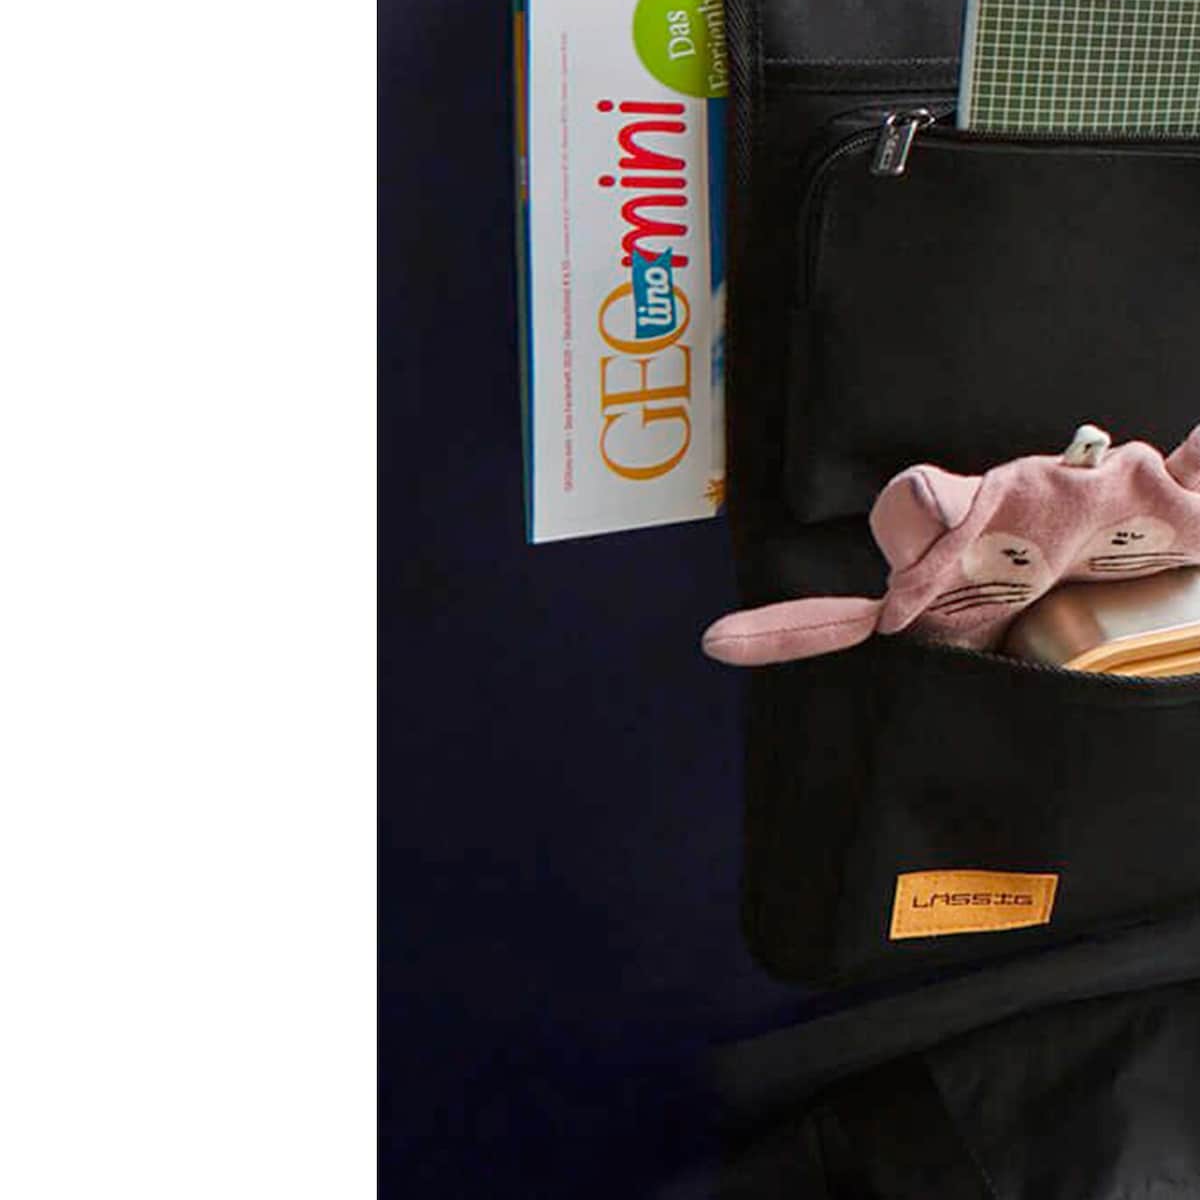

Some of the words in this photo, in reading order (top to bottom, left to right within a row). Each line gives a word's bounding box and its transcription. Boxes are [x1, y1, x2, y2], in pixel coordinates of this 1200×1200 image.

[667, 10, 696, 60] Das
[597, 100, 689, 268] mini
[637, 266, 673, 326] lino
[597, 280, 691, 480] GEO
